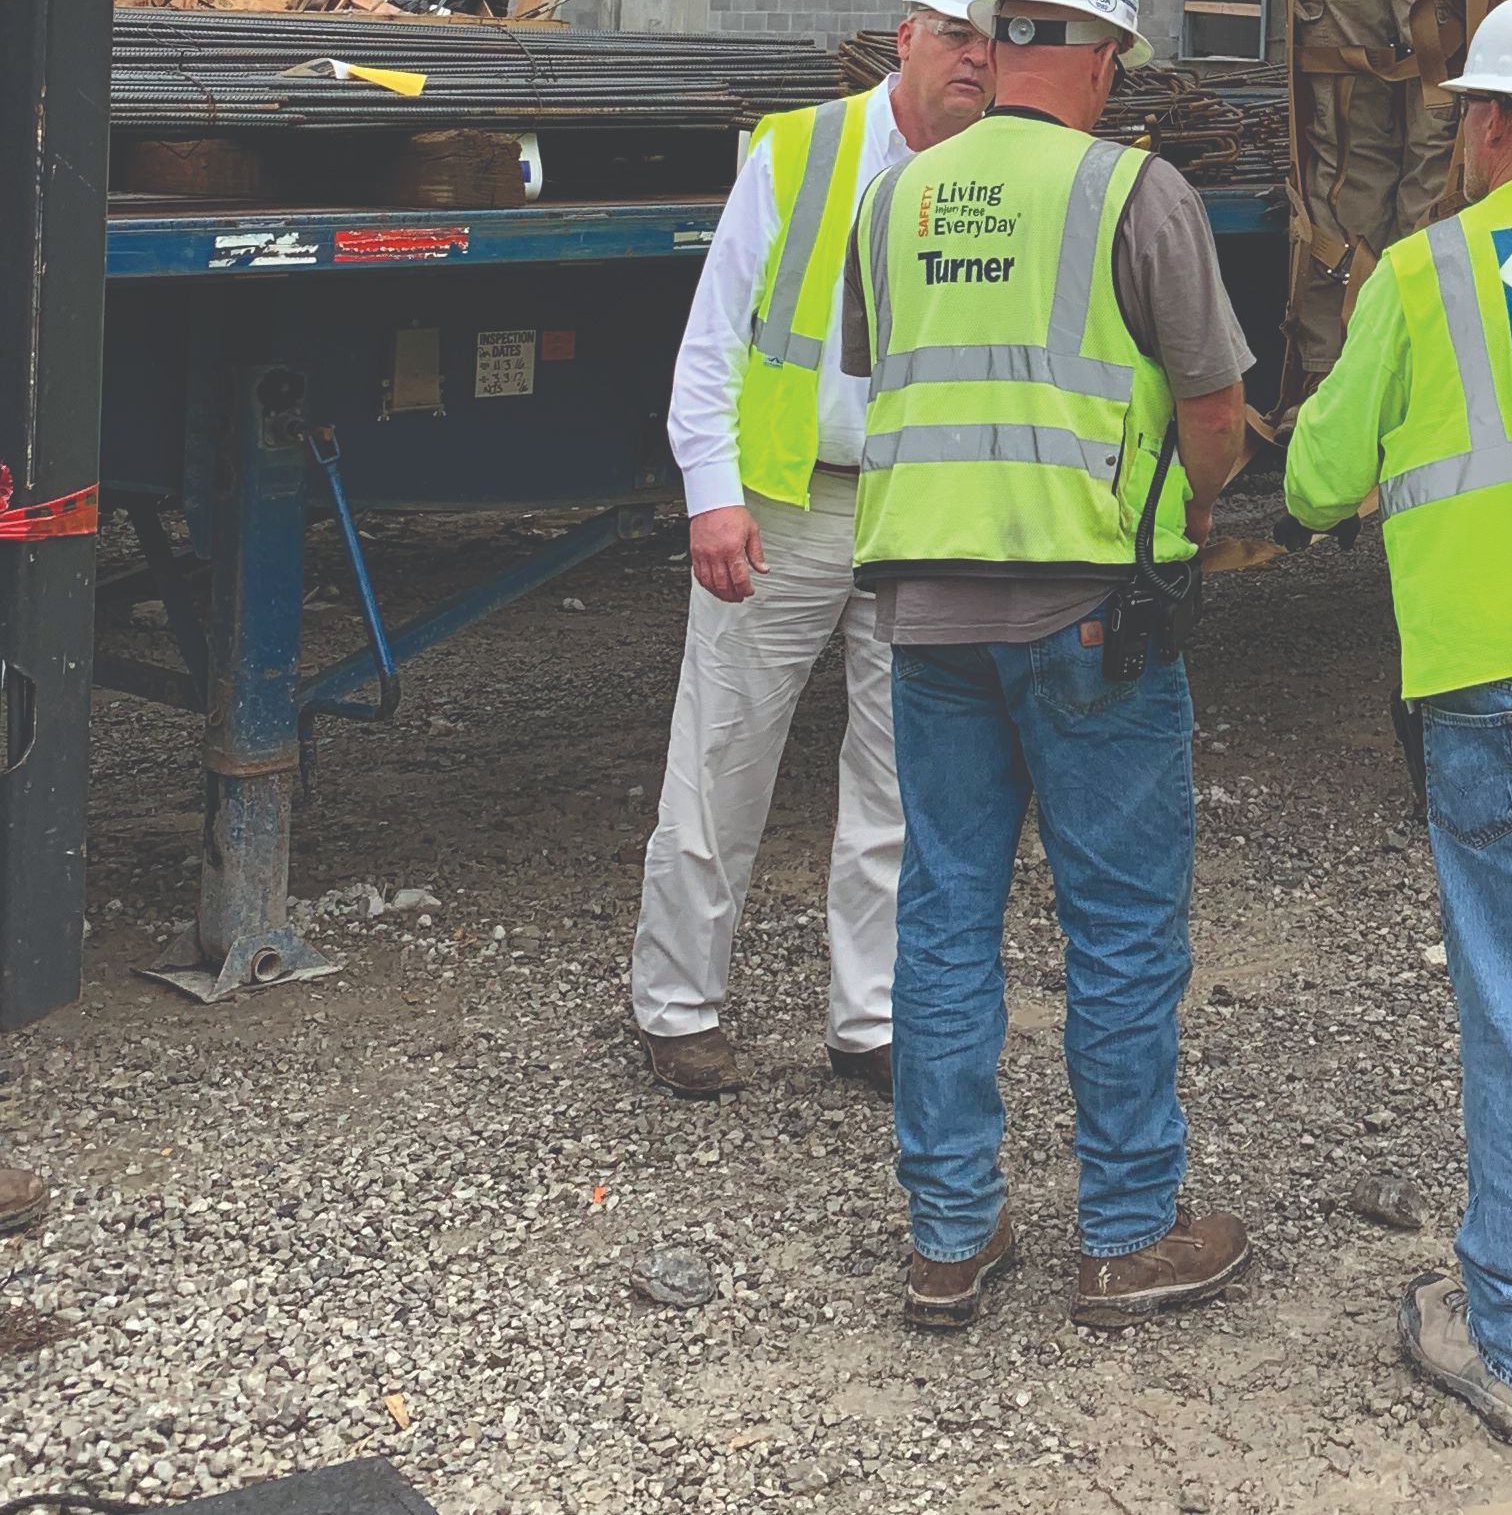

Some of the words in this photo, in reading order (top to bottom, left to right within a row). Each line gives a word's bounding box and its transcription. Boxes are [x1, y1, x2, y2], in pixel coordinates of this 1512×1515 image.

[937, 180, 1005, 207] Living
[918, 185, 934, 238] SAFETY
[960, 205, 986, 217] Free
[917, 250, 1015, 285] Turner
[480, 331, 535, 346] INSPECTION
[492, 345, 522, 358] DATES
